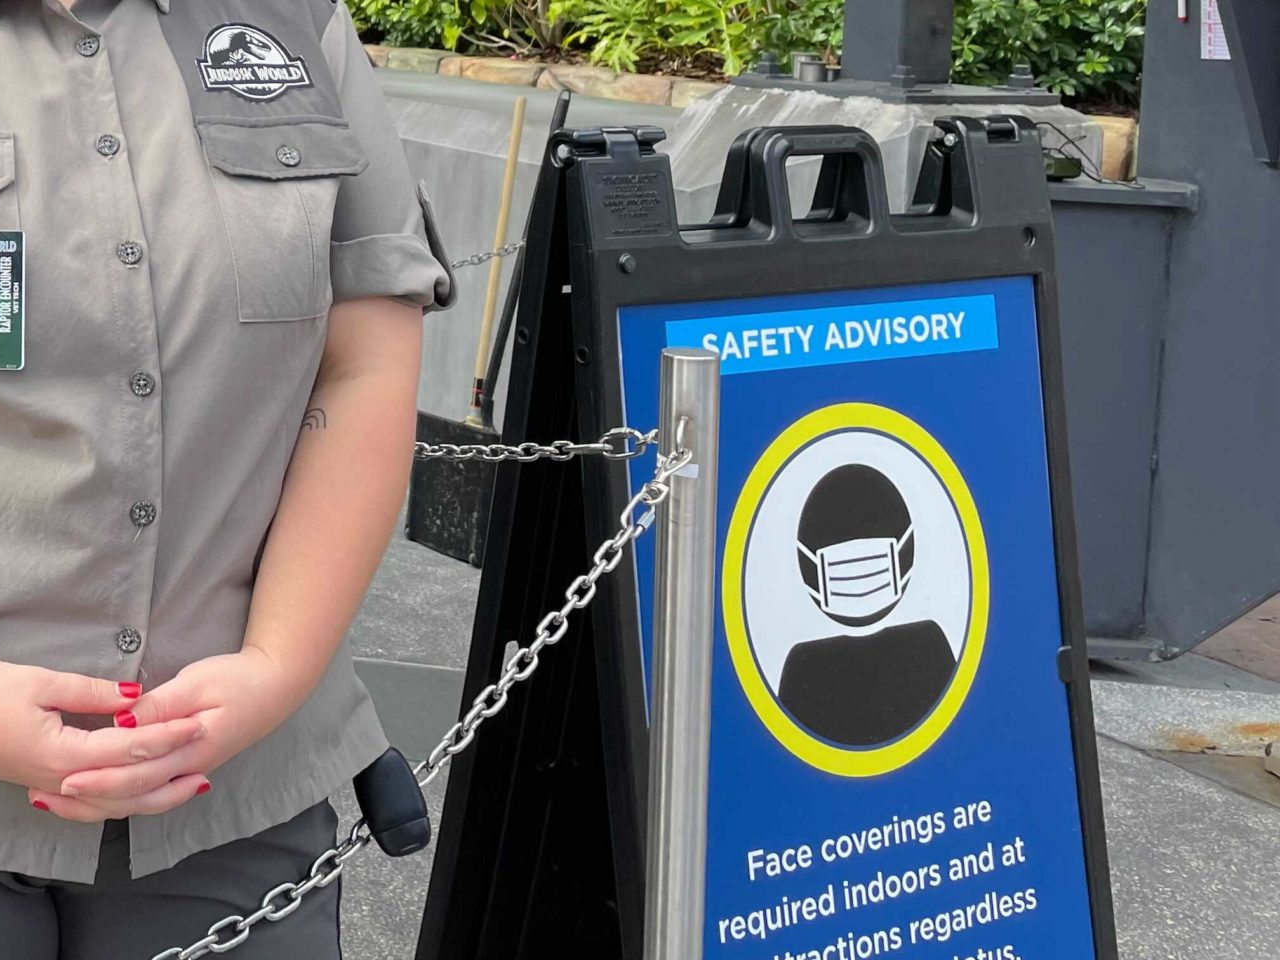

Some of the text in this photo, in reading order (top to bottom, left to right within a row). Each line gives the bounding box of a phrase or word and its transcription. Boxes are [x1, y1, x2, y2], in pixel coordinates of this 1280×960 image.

[207, 66, 302, 82] JURASSIC WORLD
[0, 256, 12, 333] RAPTOR ENCOUNTER
[12, 282, 20, 314] VET TECH
[702, 312, 966, 360] SAFETY ADVISORY
[747, 800, 992, 881] Face coverings are
[718, 836, 1026, 943] required indoors and at
[909, 888, 1037, 942] regardless
